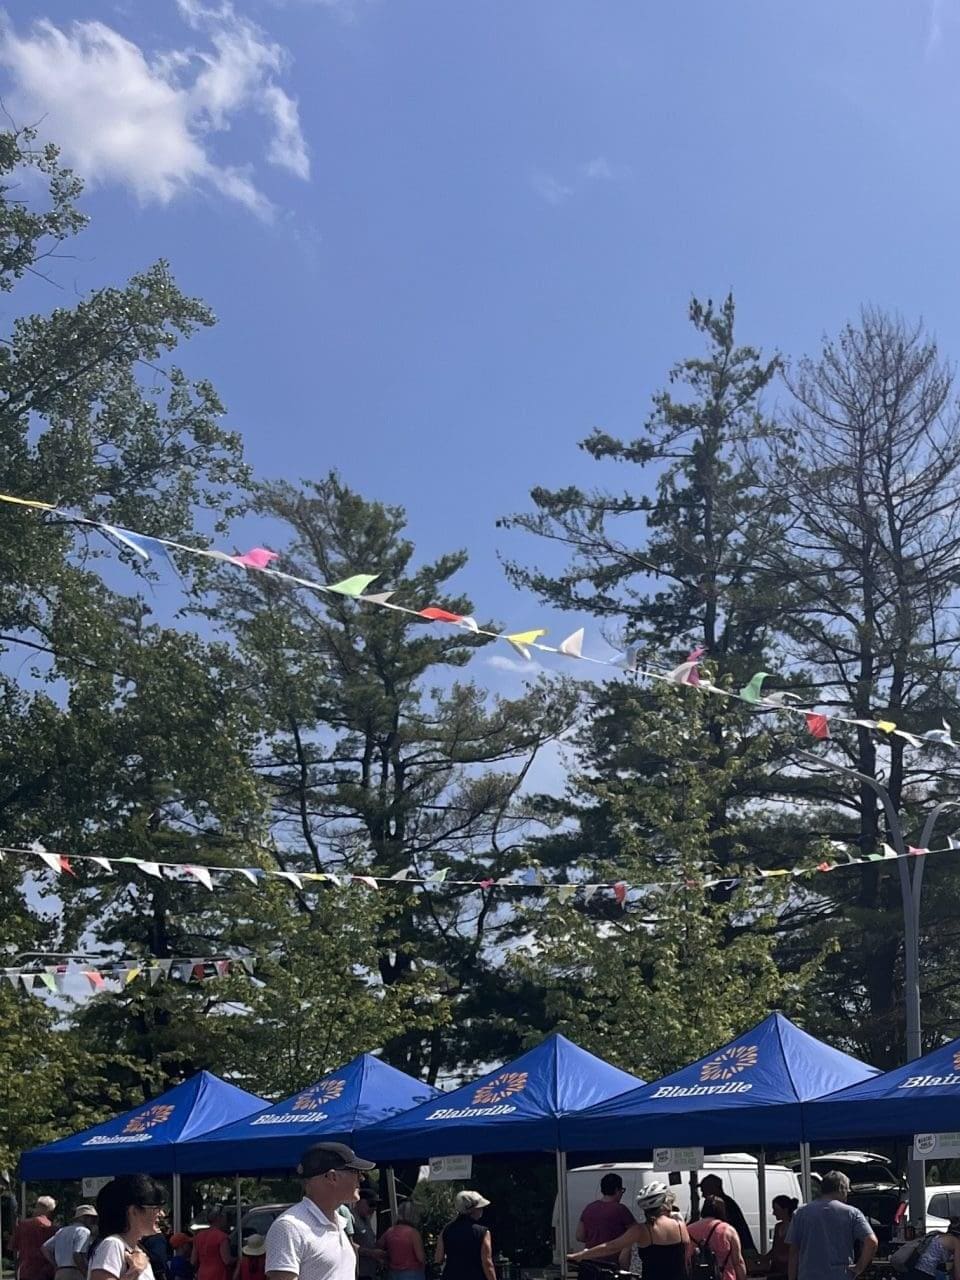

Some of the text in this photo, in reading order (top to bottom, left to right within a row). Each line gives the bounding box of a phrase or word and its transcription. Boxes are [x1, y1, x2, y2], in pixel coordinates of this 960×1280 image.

[650, 1081, 753, 1098] Blainville
[250, 1112, 329, 1125] Blainville
[425, 1104, 517, 1121] Blainville
[82, 1133, 152, 1146] Blainville
